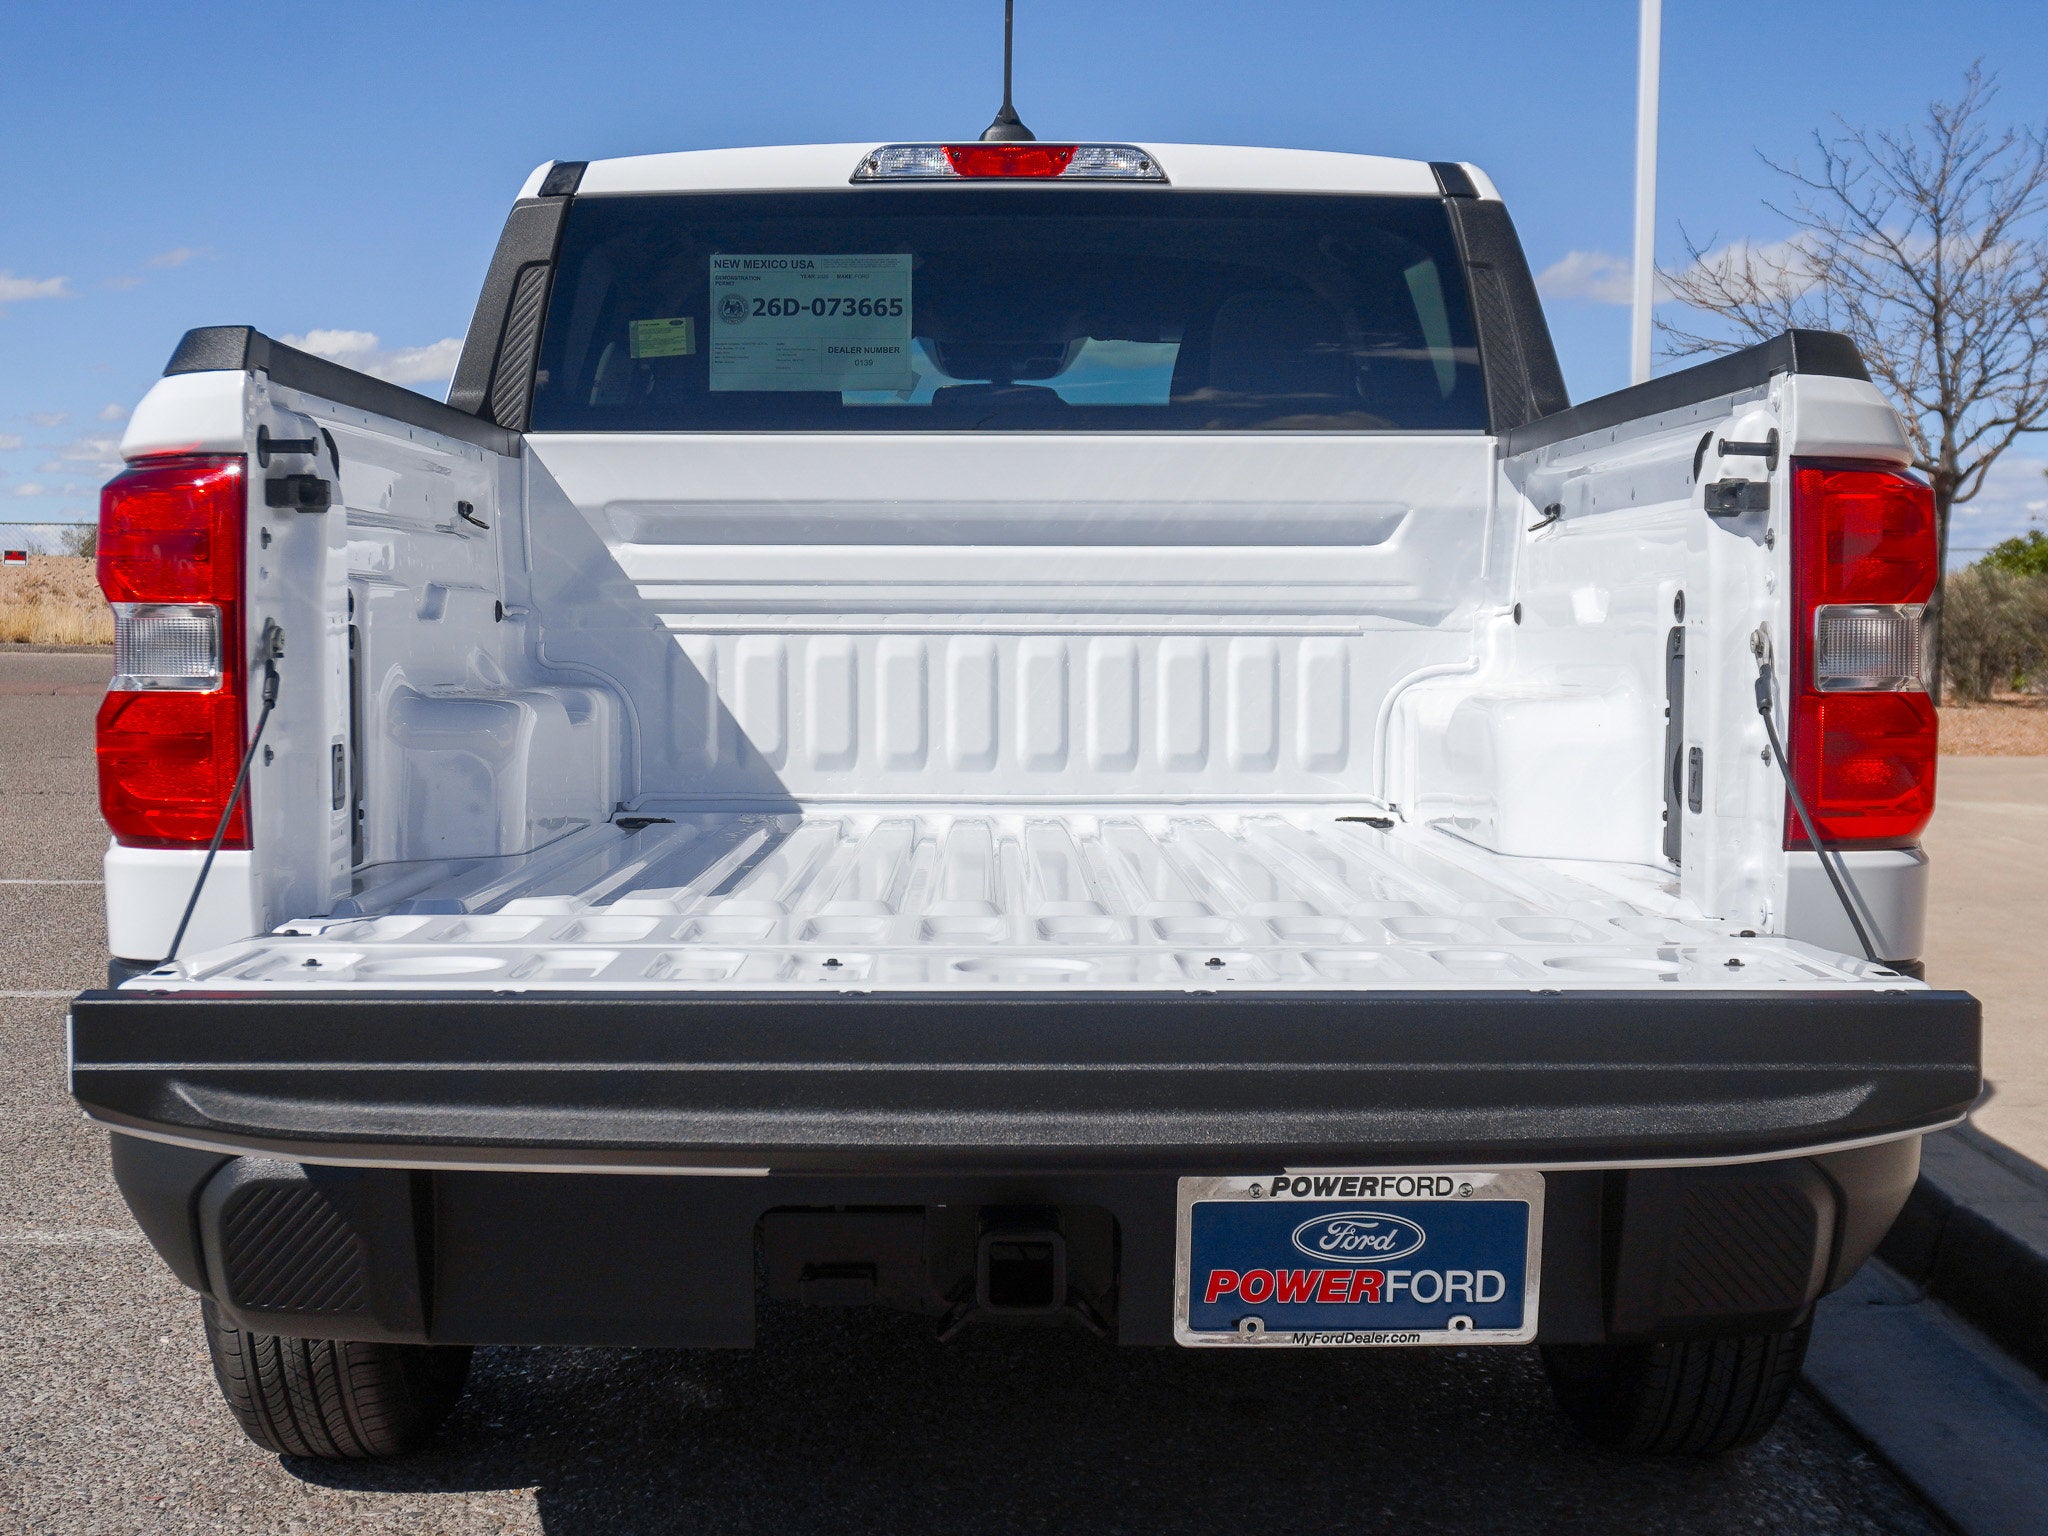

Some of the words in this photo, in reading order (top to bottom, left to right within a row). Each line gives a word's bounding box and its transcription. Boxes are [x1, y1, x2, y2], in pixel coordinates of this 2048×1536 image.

[714, 259, 740, 269] NEW
[744, 259, 788, 269] MEXICO
[791, 259, 815, 269] USA
[752, 297, 903, 317] 26D-073665
[827, 346, 862, 354] DEALER
[863, 346, 900, 354] NUMBER
[854, 359, 874, 367] 0139
[1269, 1176, 1454, 1197] POWERFORD
[1319, 1221, 1398, 1251] Ford
[1203, 1269, 1506, 1304] POWERFORD
[1292, 1332, 1420, 1346] MyFordDealer.com
